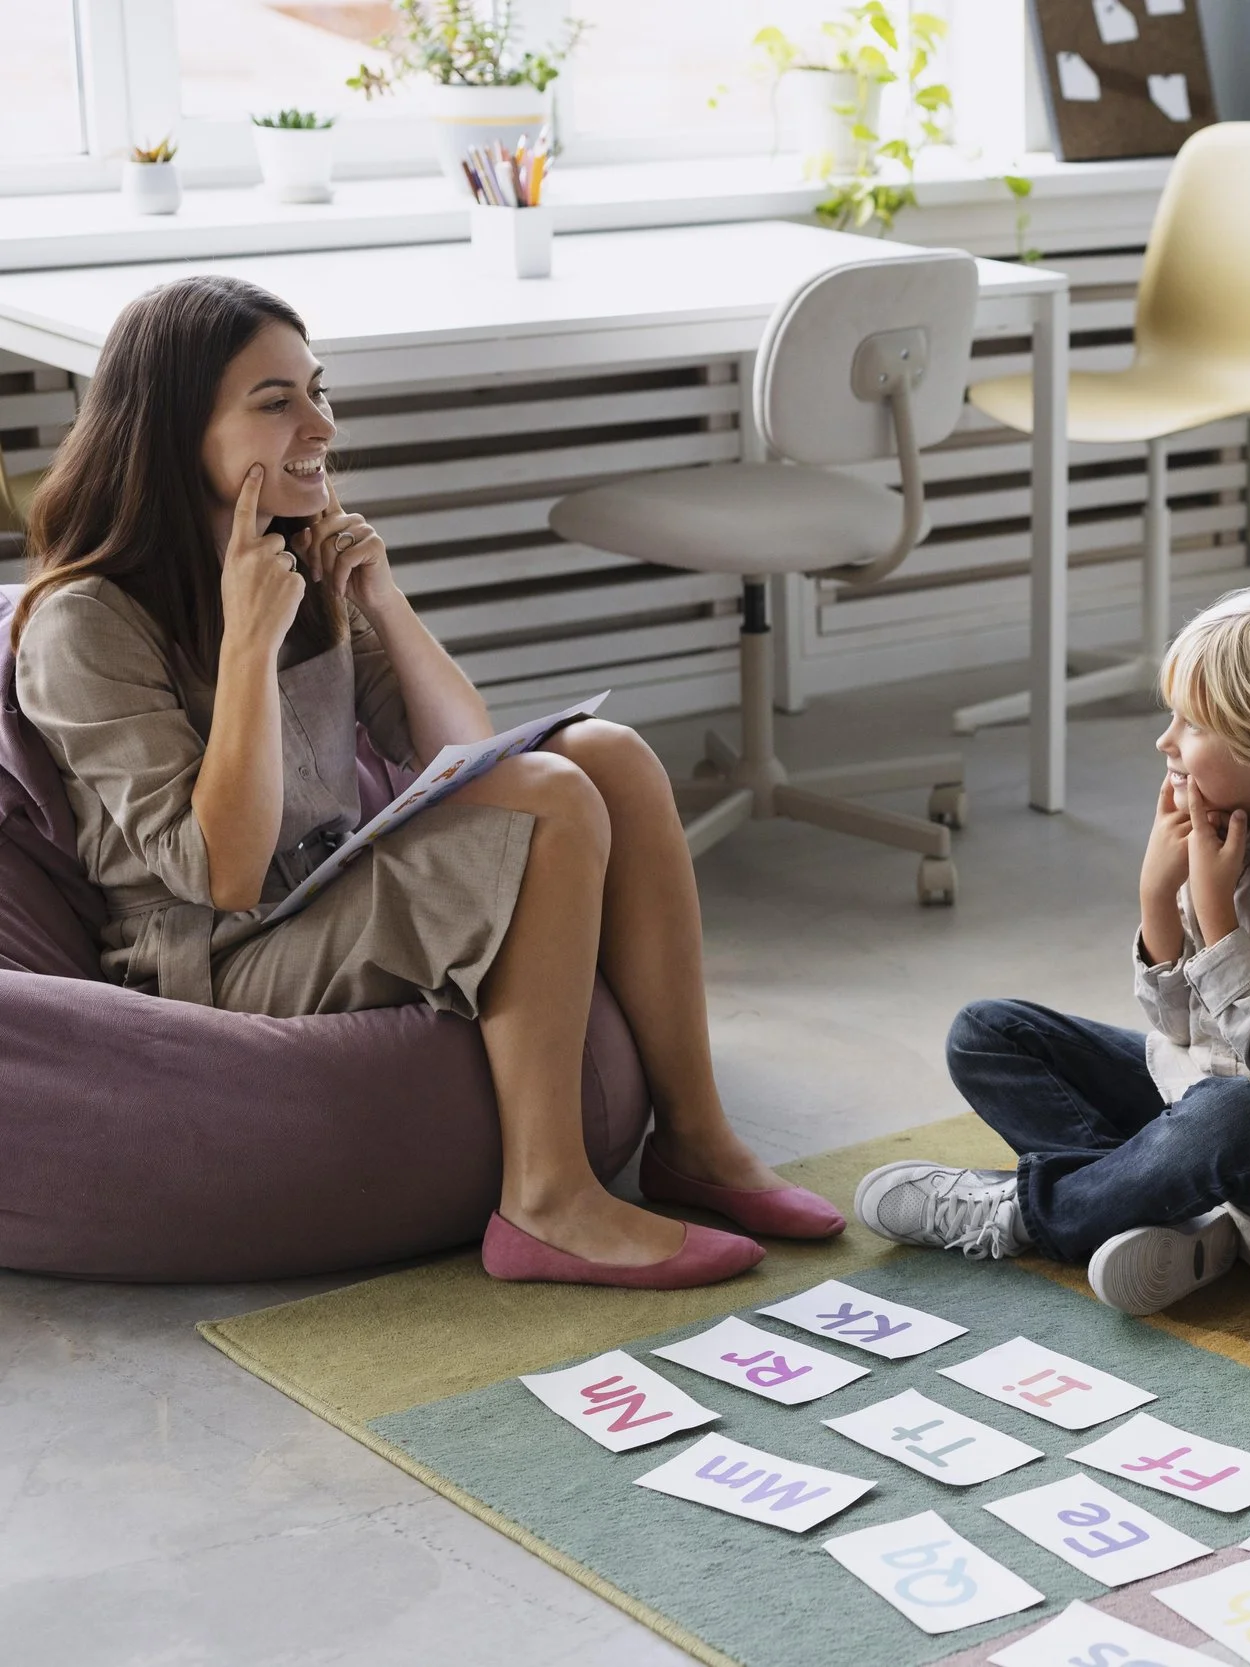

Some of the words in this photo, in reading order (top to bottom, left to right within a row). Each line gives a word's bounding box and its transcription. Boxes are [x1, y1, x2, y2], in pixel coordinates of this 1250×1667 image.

[815, 1302, 913, 1343] Kk
[719, 1349, 814, 1388] Rr
[1001, 1368, 1093, 1408] Ii
[579, 1375, 674, 1433] Nn
[890, 1419, 977, 1469] Tt
[694, 1454, 832, 1513] Mm
[1119, 1446, 1241, 1493] Ff
[1056, 1501, 1151, 1559] Ee
[881, 1540, 978, 1608] Qq
[1067, 1642, 1170, 1667] s
